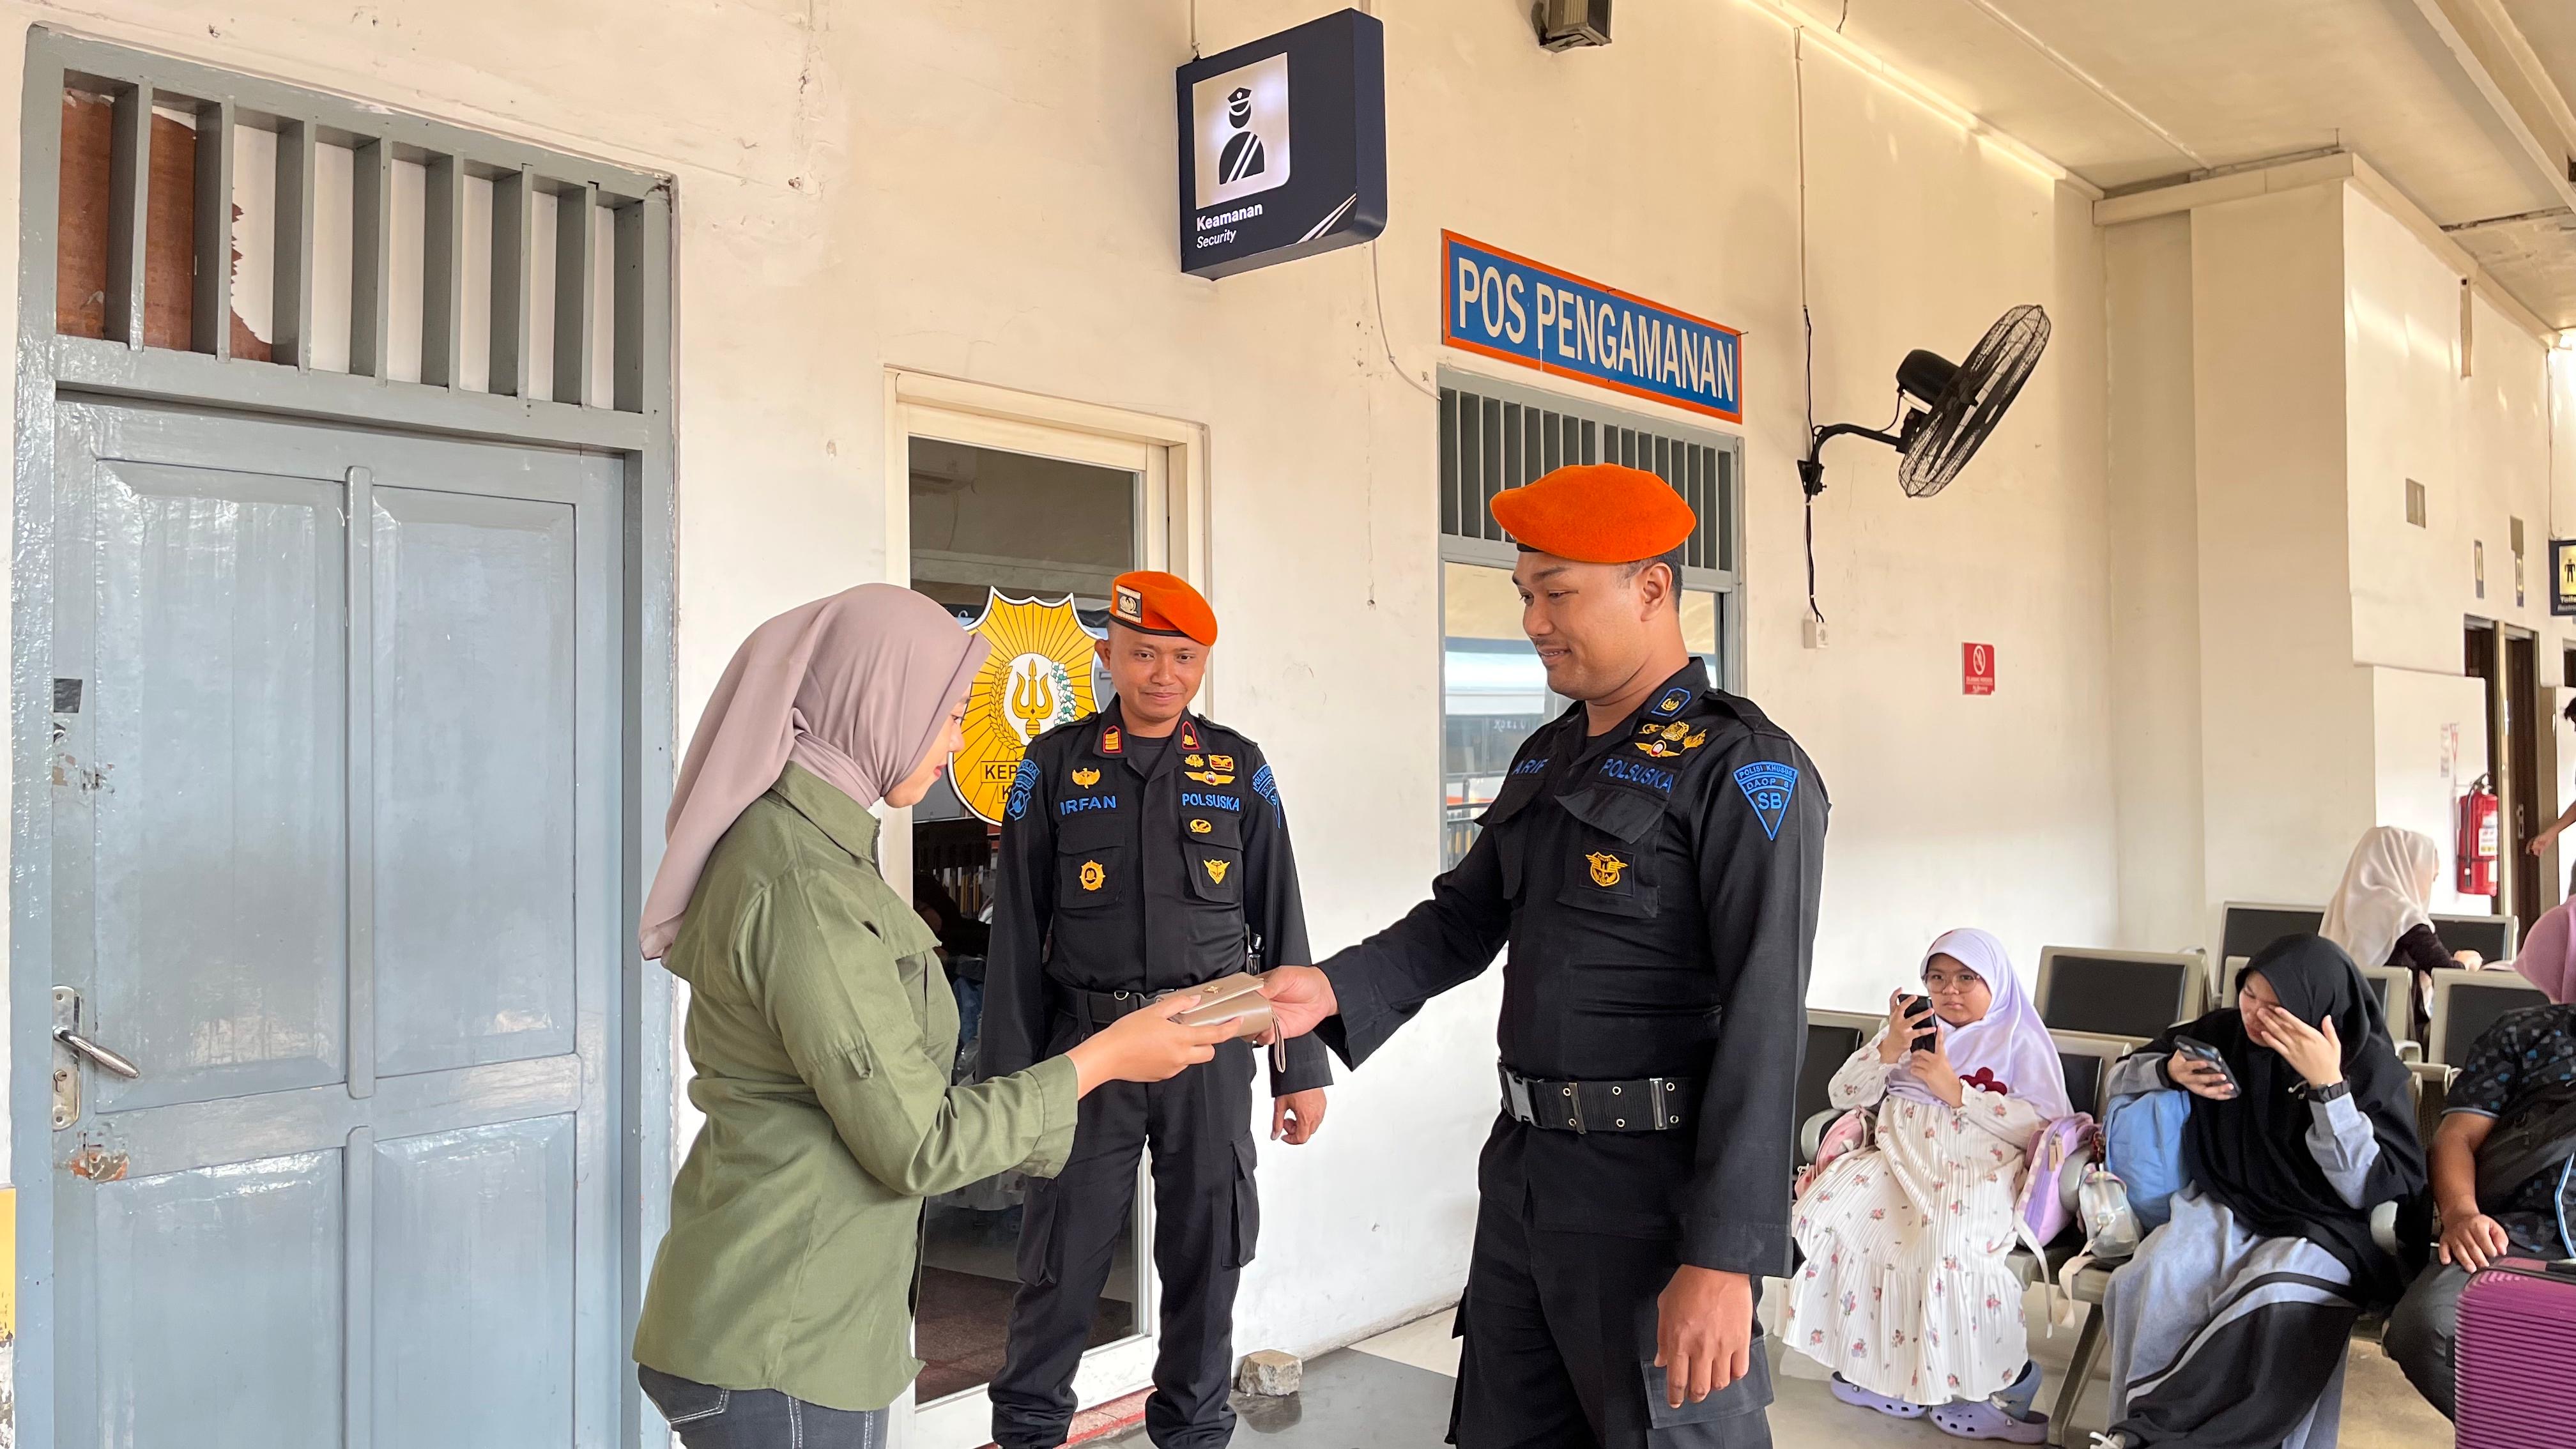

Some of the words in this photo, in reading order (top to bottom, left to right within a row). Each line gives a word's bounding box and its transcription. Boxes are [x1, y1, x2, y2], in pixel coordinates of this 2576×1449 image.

[1196, 203, 1262, 231] Keamanan
[1197, 229, 1237, 249] Security
[1458, 257, 1526, 344] POS
[1537, 282, 1733, 402] PENGAMANAN
[1512, 759, 1549, 776] ARIF
[1602, 758, 1674, 793] POLSUSKA
[1739, 765, 1763, 779] POLISI
[1767, 765, 1793, 776] KHUSUS
[1747, 778, 1776, 790] DAOP
[1060, 795, 1116, 815] IRFAN
[1182, 793, 1239, 811] POLSUSKA
[1758, 792, 1782, 810] SB
